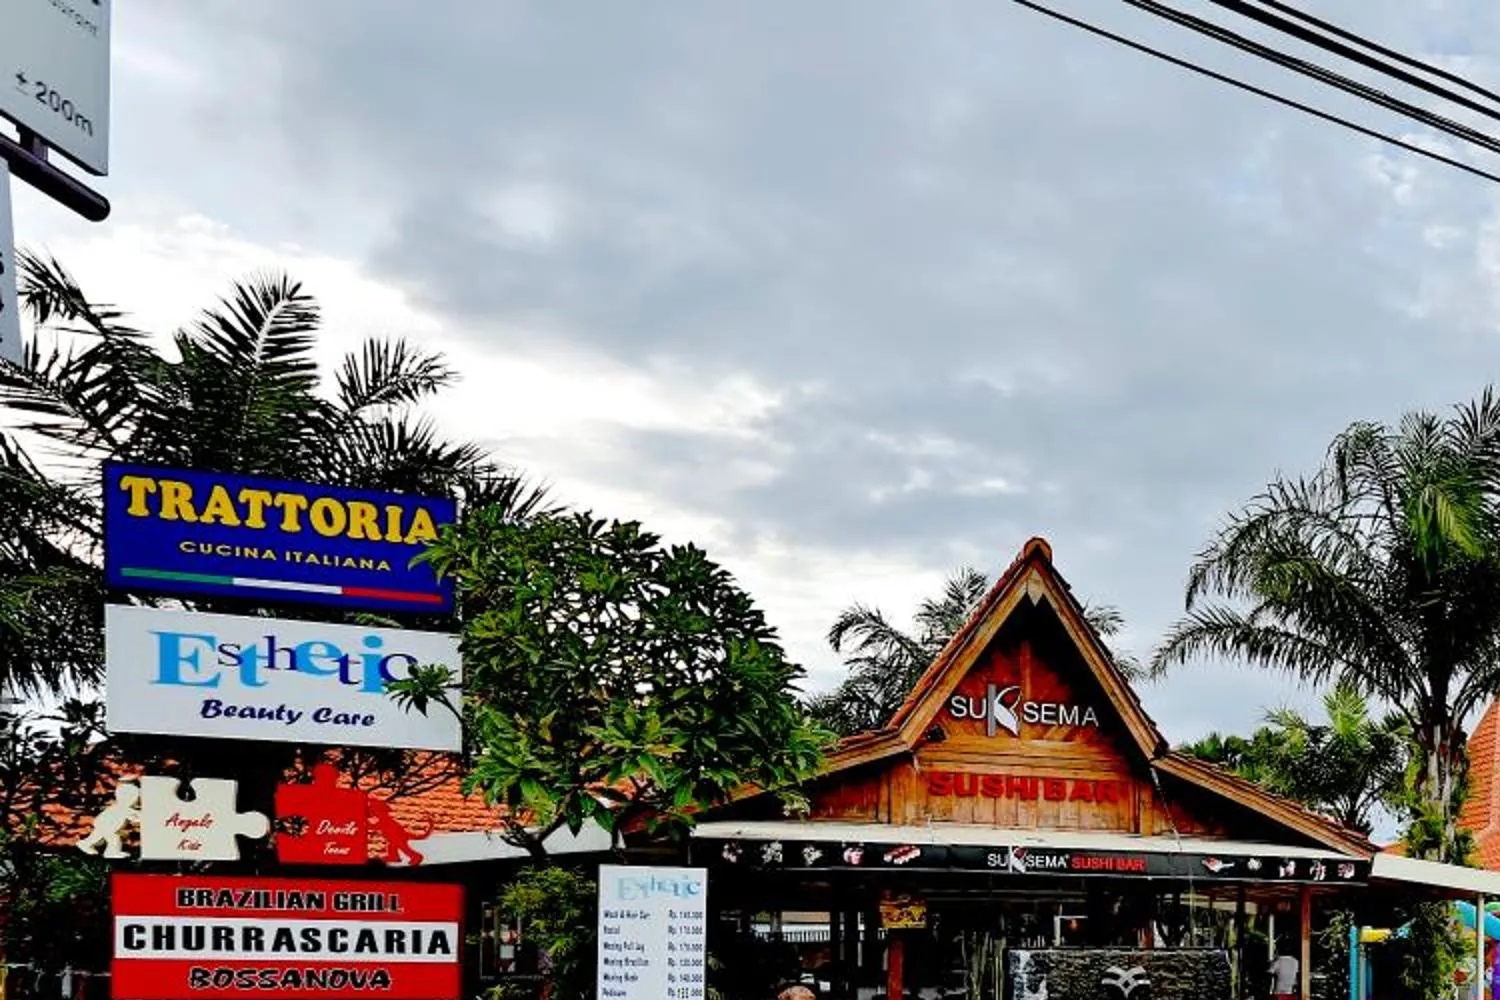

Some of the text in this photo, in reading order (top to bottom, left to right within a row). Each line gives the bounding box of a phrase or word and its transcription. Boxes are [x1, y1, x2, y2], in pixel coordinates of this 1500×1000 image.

[34, 80, 94, 137] 200m
[119, 475, 439, 546] TRATTORIA
[179, 540, 391, 571] CUCINA ITALIANA
[148, 630, 420, 694] Esthetic
[200, 699, 376, 727] Beauty Care
[928, 771, 1120, 805] SUSHI BAR
[1071, 857, 1113, 870] SUSHI
[1116, 858, 1146, 871] BAR
[175, 888, 404, 914] BRAZILIAN GRILL
[122, 923, 451, 955] CHURRASCARIA
[188, 966, 391, 991] BOSSANOVA
